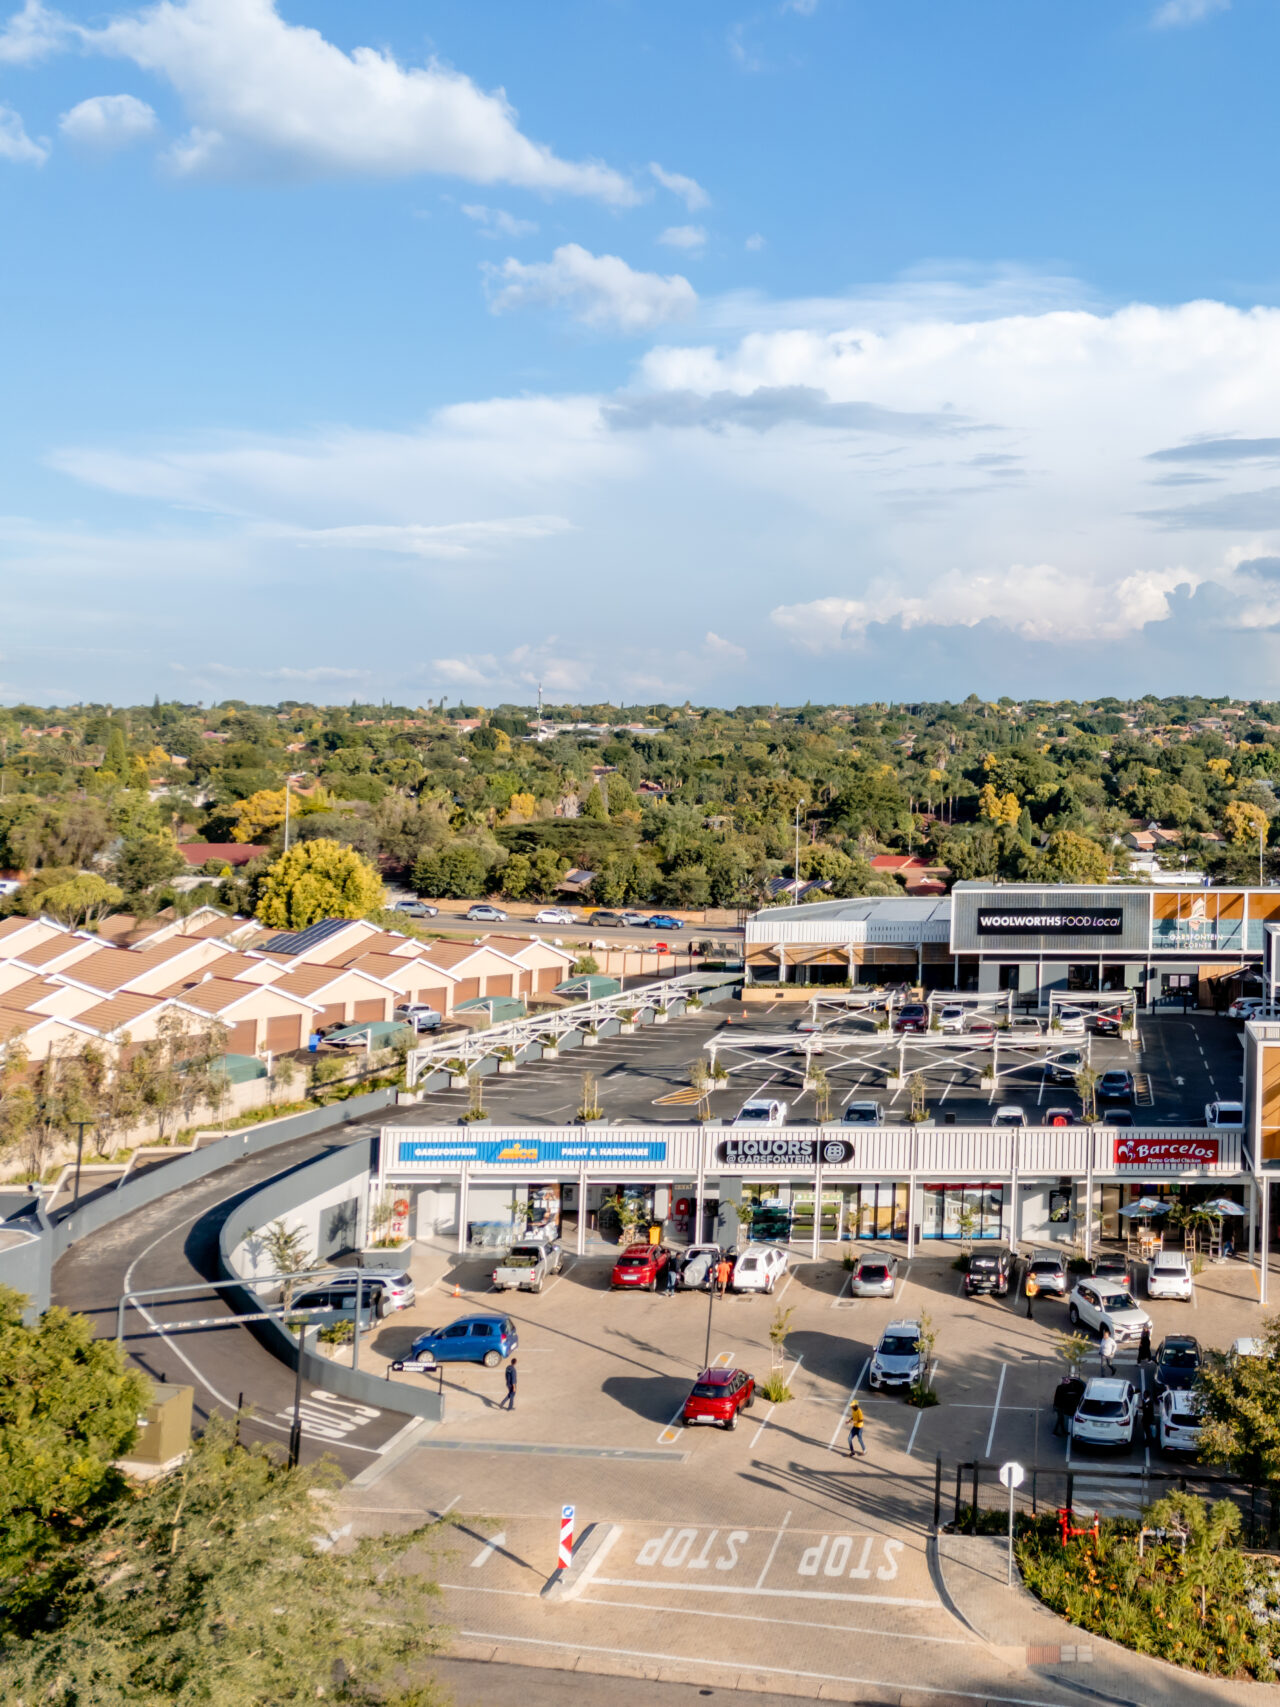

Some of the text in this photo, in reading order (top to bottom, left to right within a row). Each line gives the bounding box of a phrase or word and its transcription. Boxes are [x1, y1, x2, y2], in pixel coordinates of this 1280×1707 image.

[980, 916, 1061, 926] WOOLWORTHS
[414, 1147, 477, 1157] GARSFONTEIN
[561, 1148, 588, 1156] PAINT
[590, 1148, 597, 1156] &
[600, 1148, 649, 1156] HARDWARE
[726, 1141, 813, 1155] LIQUORS
[1136, 1143, 1215, 1158] Barcelos
[726, 1155, 813, 1164] @ GARSFONTEIN
[635, 1527, 749, 1571] STOP
[797, 1535, 904, 1581] STOP
